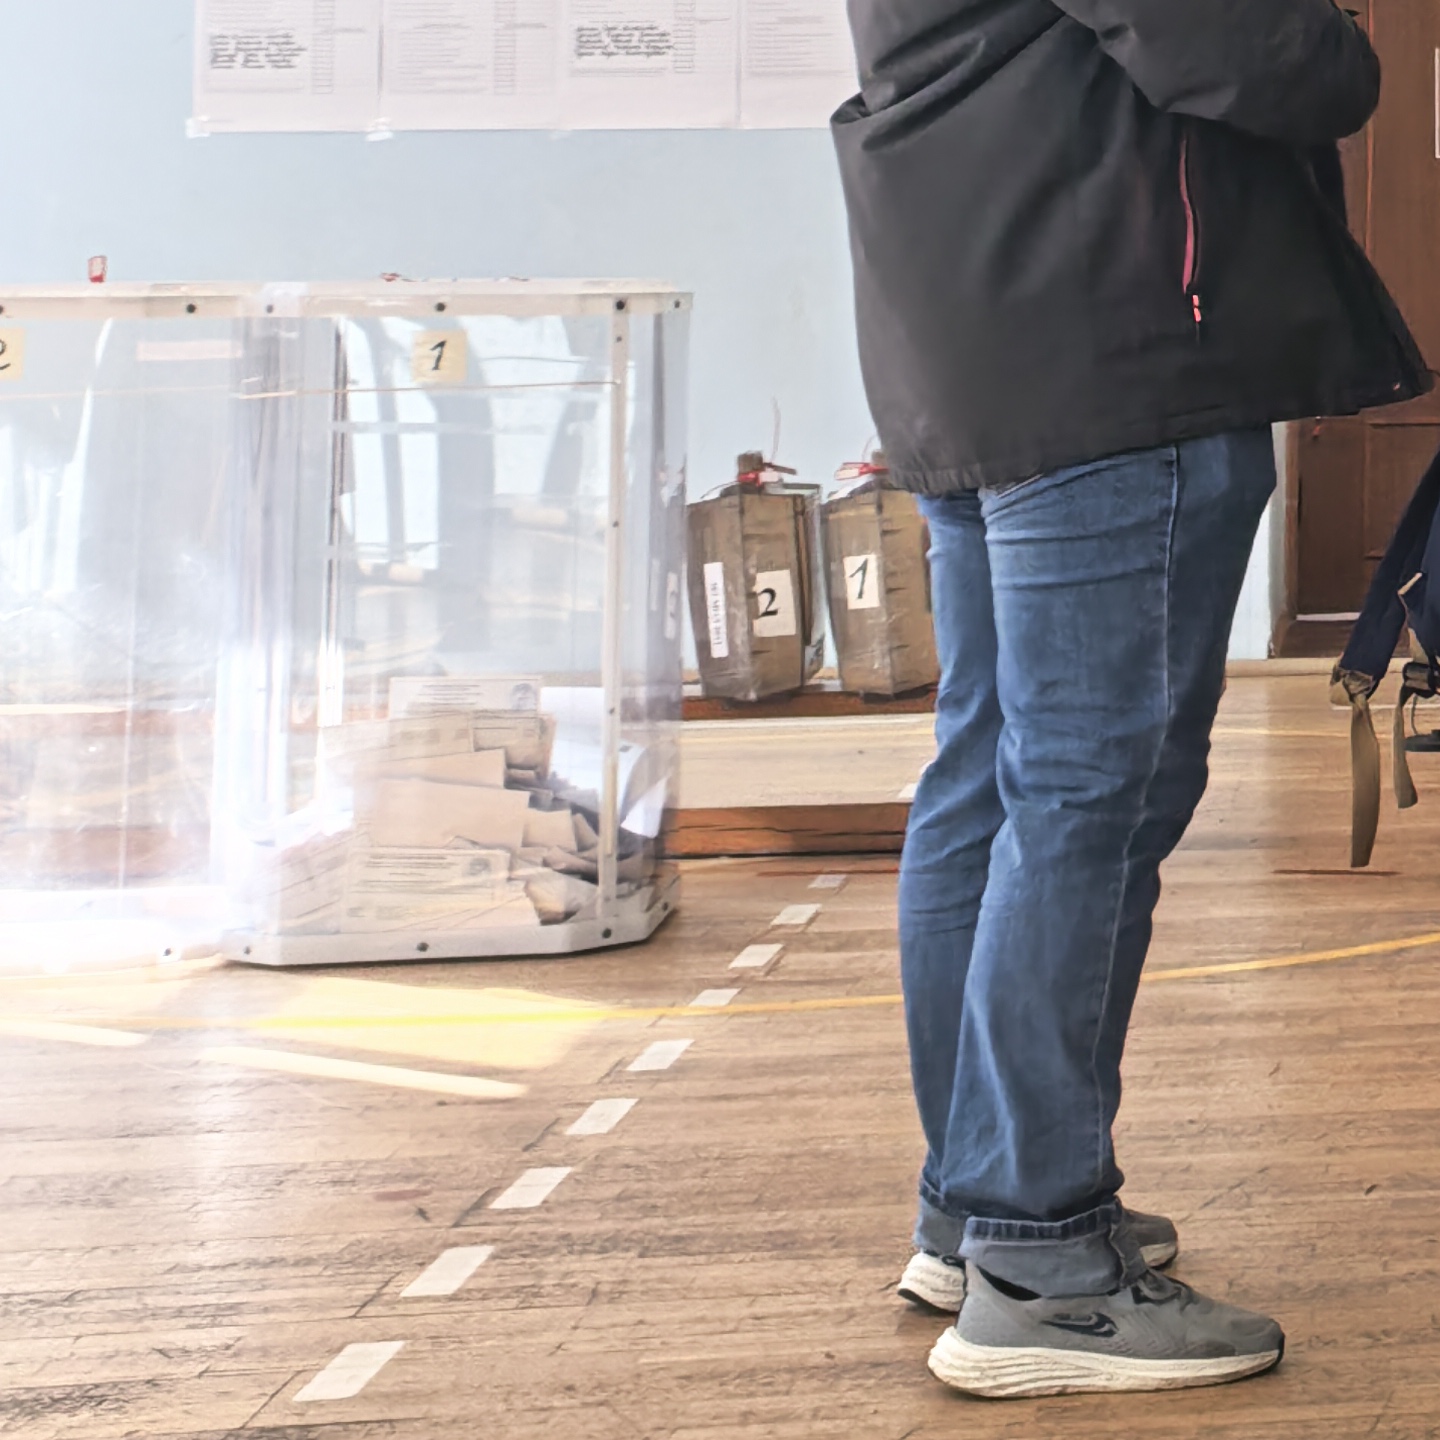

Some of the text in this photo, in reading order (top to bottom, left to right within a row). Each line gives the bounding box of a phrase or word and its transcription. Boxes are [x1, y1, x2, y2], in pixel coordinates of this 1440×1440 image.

[429, 339, 448, 371] 1
[848, 557, 870, 600] 1
[757, 587, 779, 617] 2
